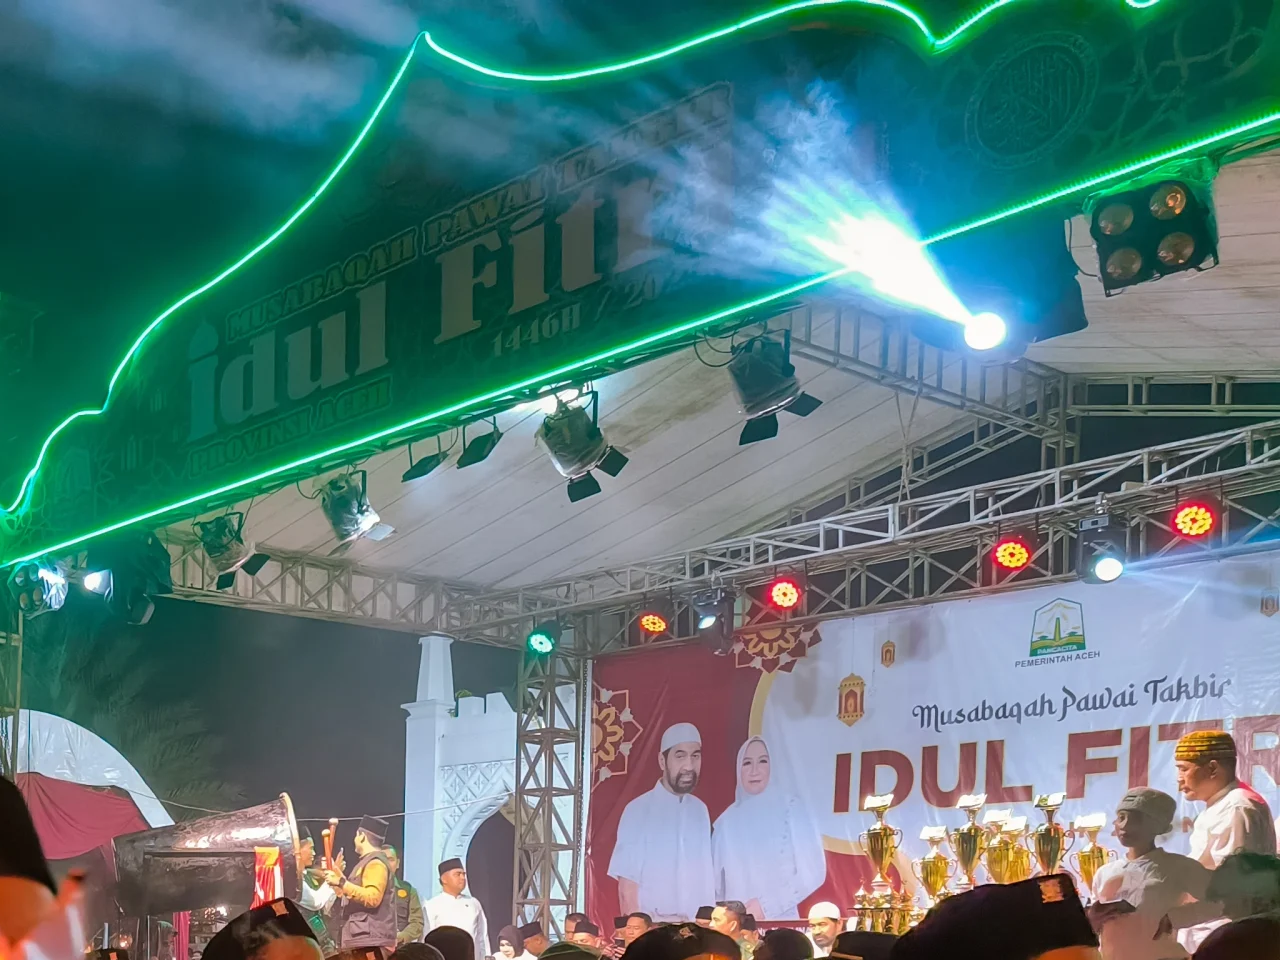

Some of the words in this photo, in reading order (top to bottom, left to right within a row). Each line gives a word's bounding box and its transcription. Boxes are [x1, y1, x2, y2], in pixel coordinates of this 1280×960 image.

[425, 169, 546, 252] PAWAI
[187, 279, 390, 446] idul
[491, 302, 583, 359] 1446H
[1014, 654, 1074, 668] PEMERINTAH
[1074, 650, 1101, 661] ACEH
[912, 692, 1058, 733] Musabaqah
[1058, 684, 1138, 723] Pawai
[1143, 673, 1232, 707] Takbir
[833, 739, 1034, 813] IDUL
